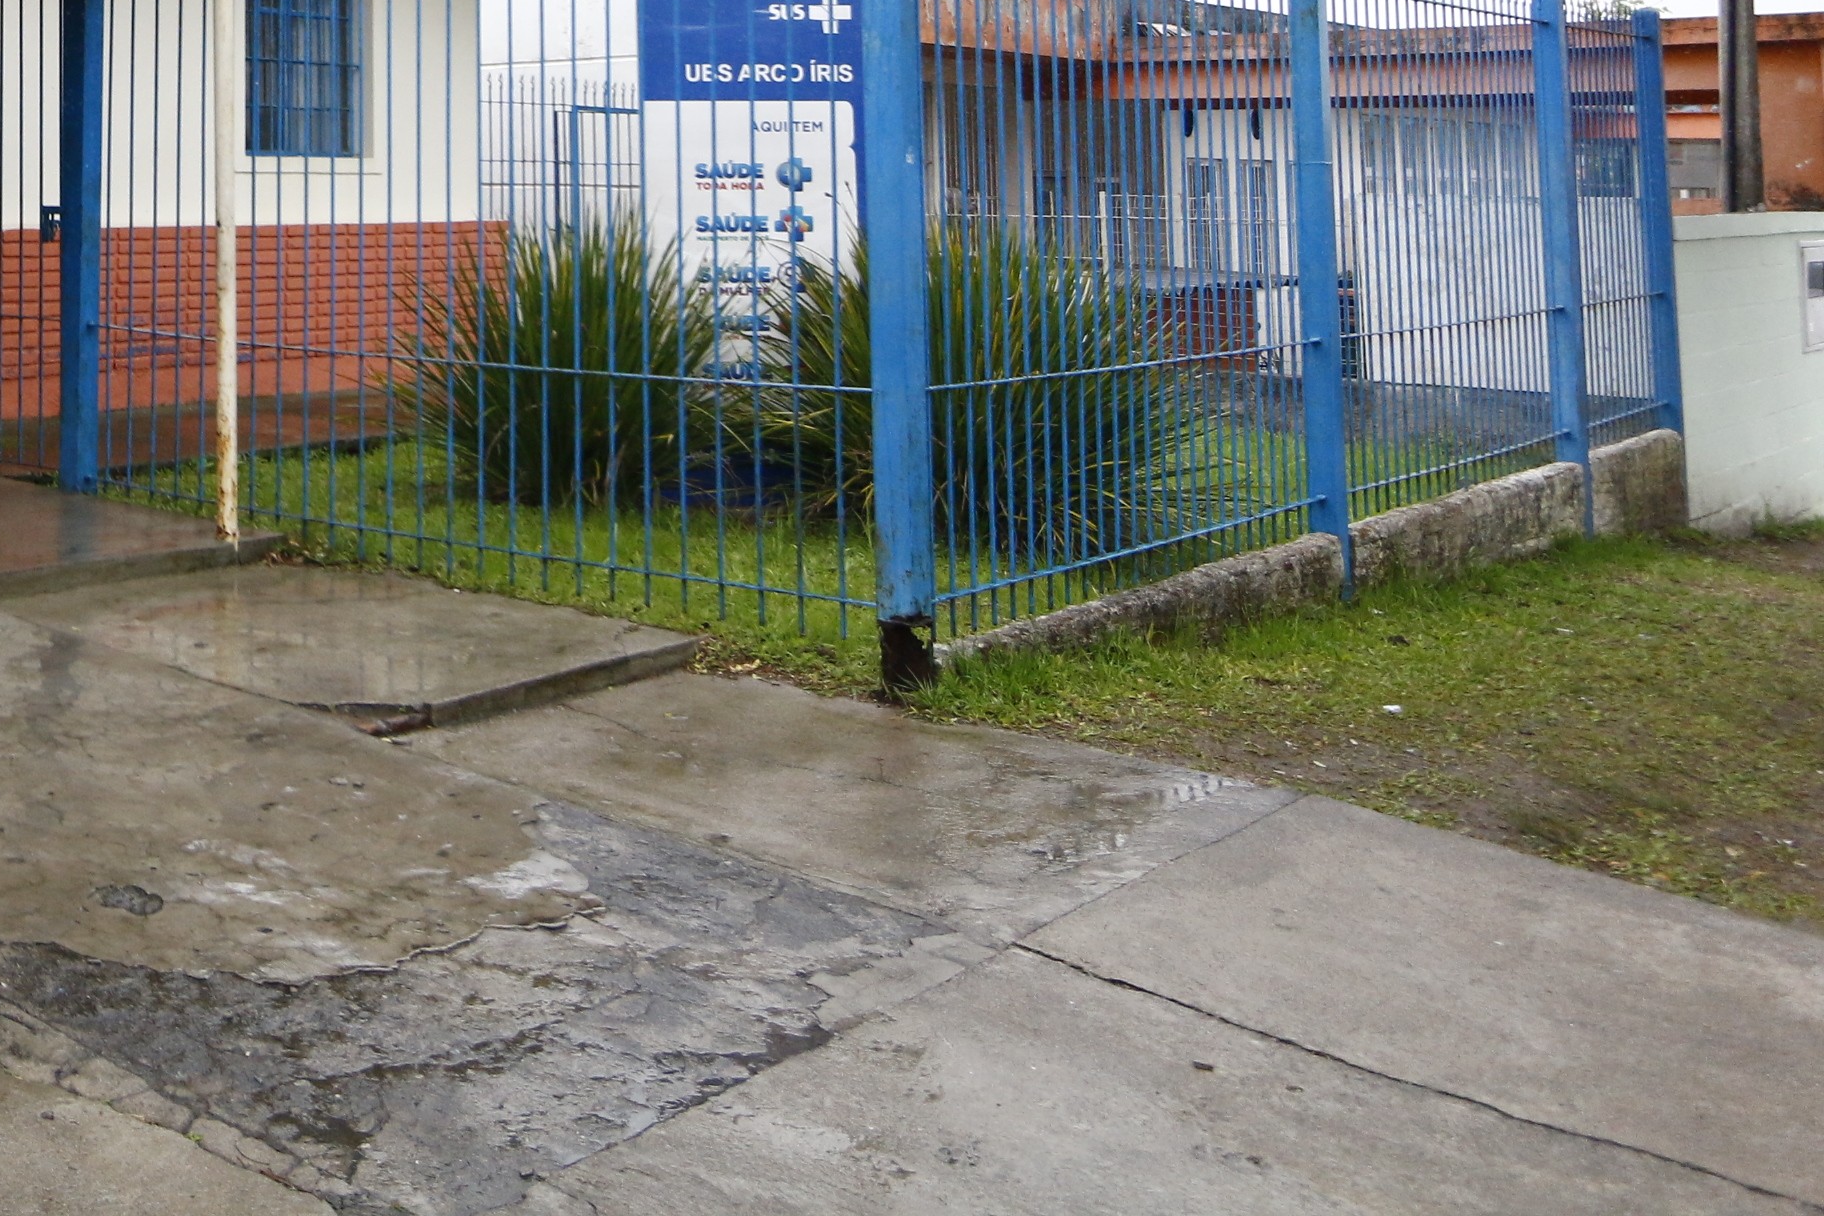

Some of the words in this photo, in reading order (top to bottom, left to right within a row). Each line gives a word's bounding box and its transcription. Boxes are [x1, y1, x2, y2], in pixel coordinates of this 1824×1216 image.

[768, 4, 806, 20] SUS
[737, 63, 805, 83] ARCO
[809, 59, 854, 83] ÍRIS
[753, 121, 788, 133] AQUI
[792, 121, 823, 133] TEM
[694, 160, 764, 179] SAÚDE
[696, 182, 727, 191] TOA
[696, 212, 769, 232] SAÚDE
